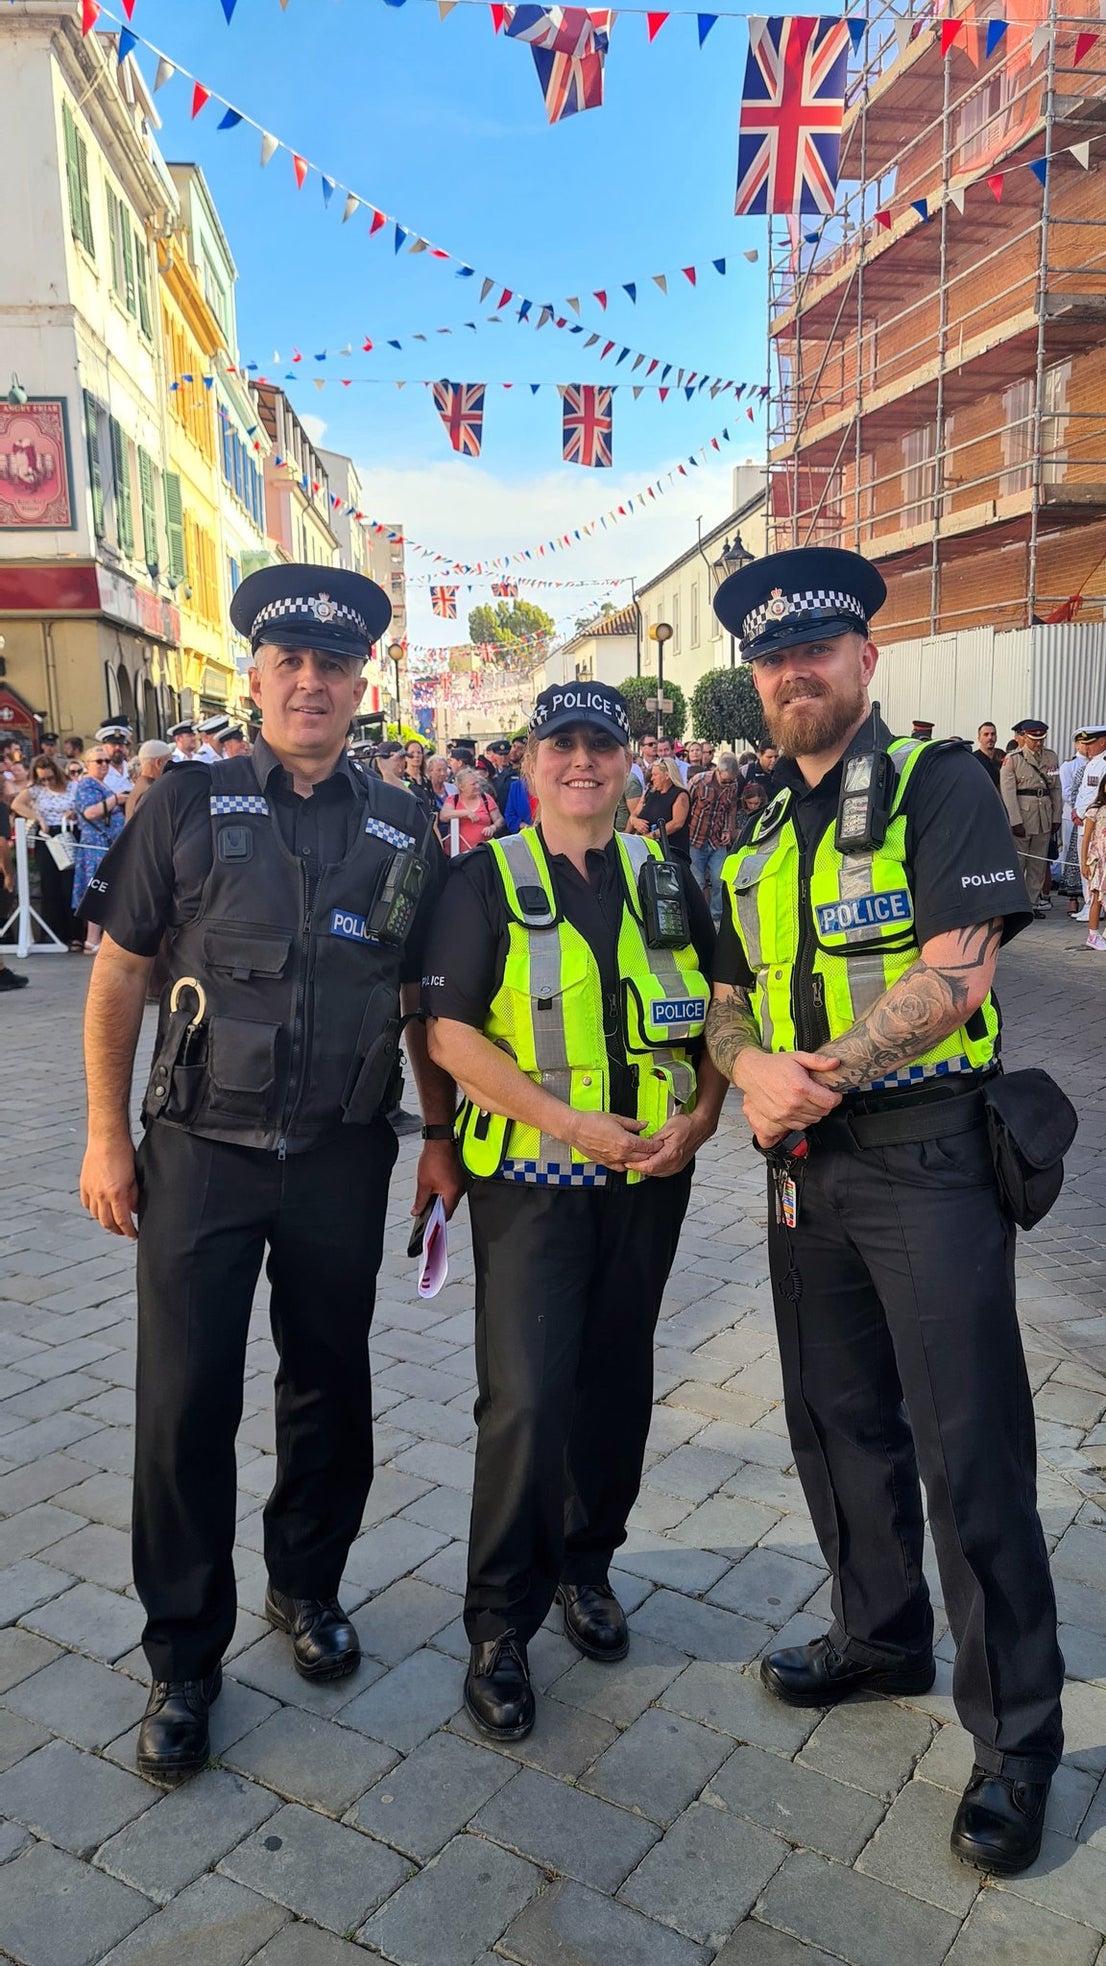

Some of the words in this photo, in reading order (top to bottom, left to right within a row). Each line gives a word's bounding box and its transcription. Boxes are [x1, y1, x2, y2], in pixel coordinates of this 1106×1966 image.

[552, 692, 612, 715] POLICE
[87, 877, 109, 893] ICE
[961, 870, 1016, 888] POLICE
[823, 894, 906, 931] POLICE
[655, 1002, 703, 1020] POLICE
